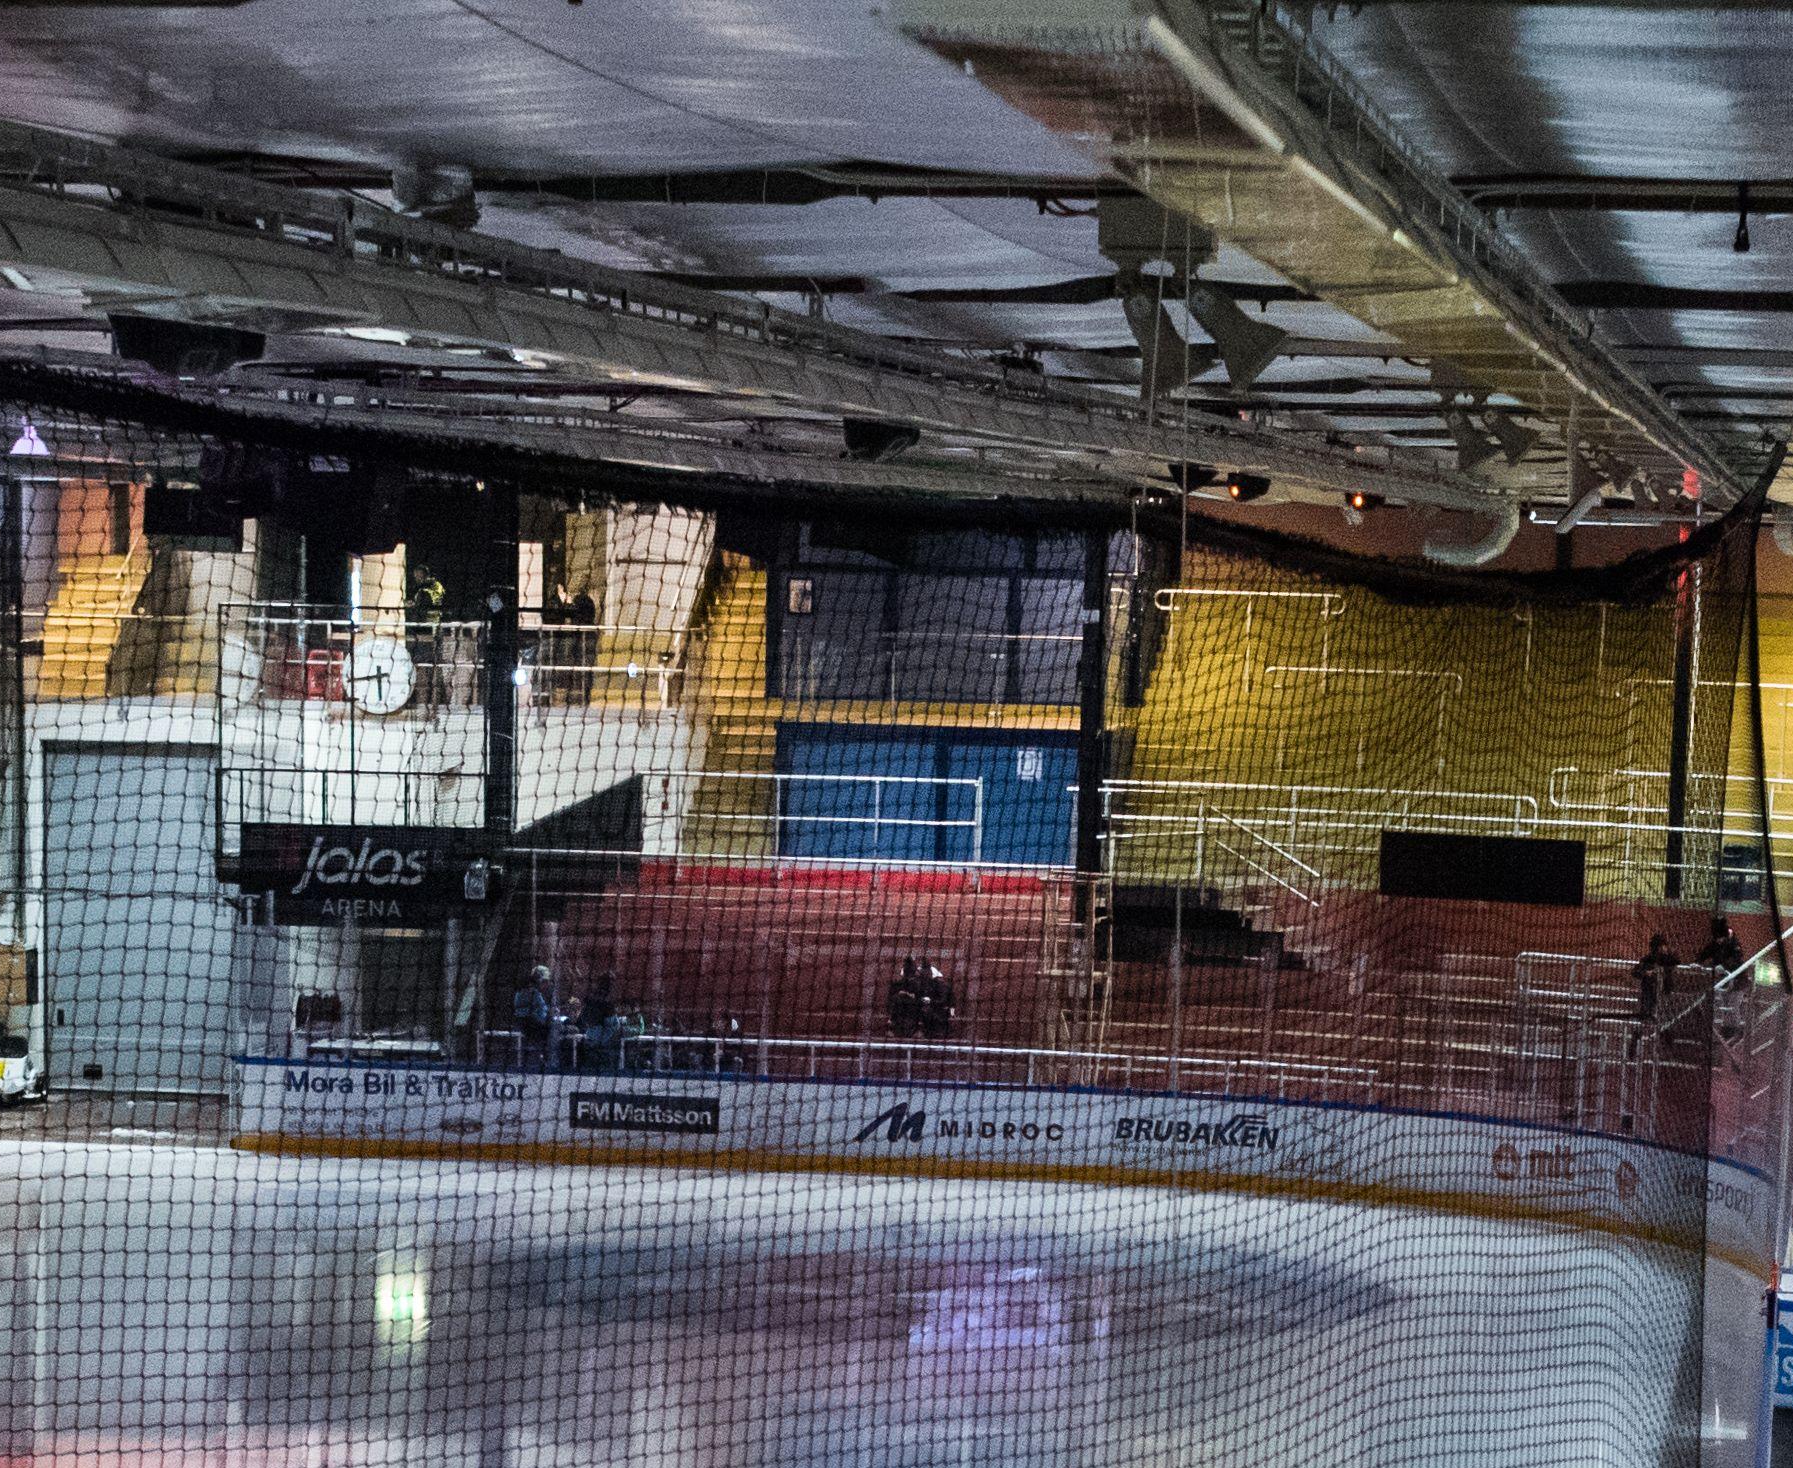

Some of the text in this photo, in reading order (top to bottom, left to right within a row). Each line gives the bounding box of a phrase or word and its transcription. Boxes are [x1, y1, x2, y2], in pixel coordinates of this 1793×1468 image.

[291, 835, 429, 895] jalas
[321, 898, 402, 919] ARENA
[285, 1069, 529, 1104] Mora Bil & Traktor
[613, 1103, 714, 1128] Mattsson
[939, 1120, 1065, 1142] MIDROC
